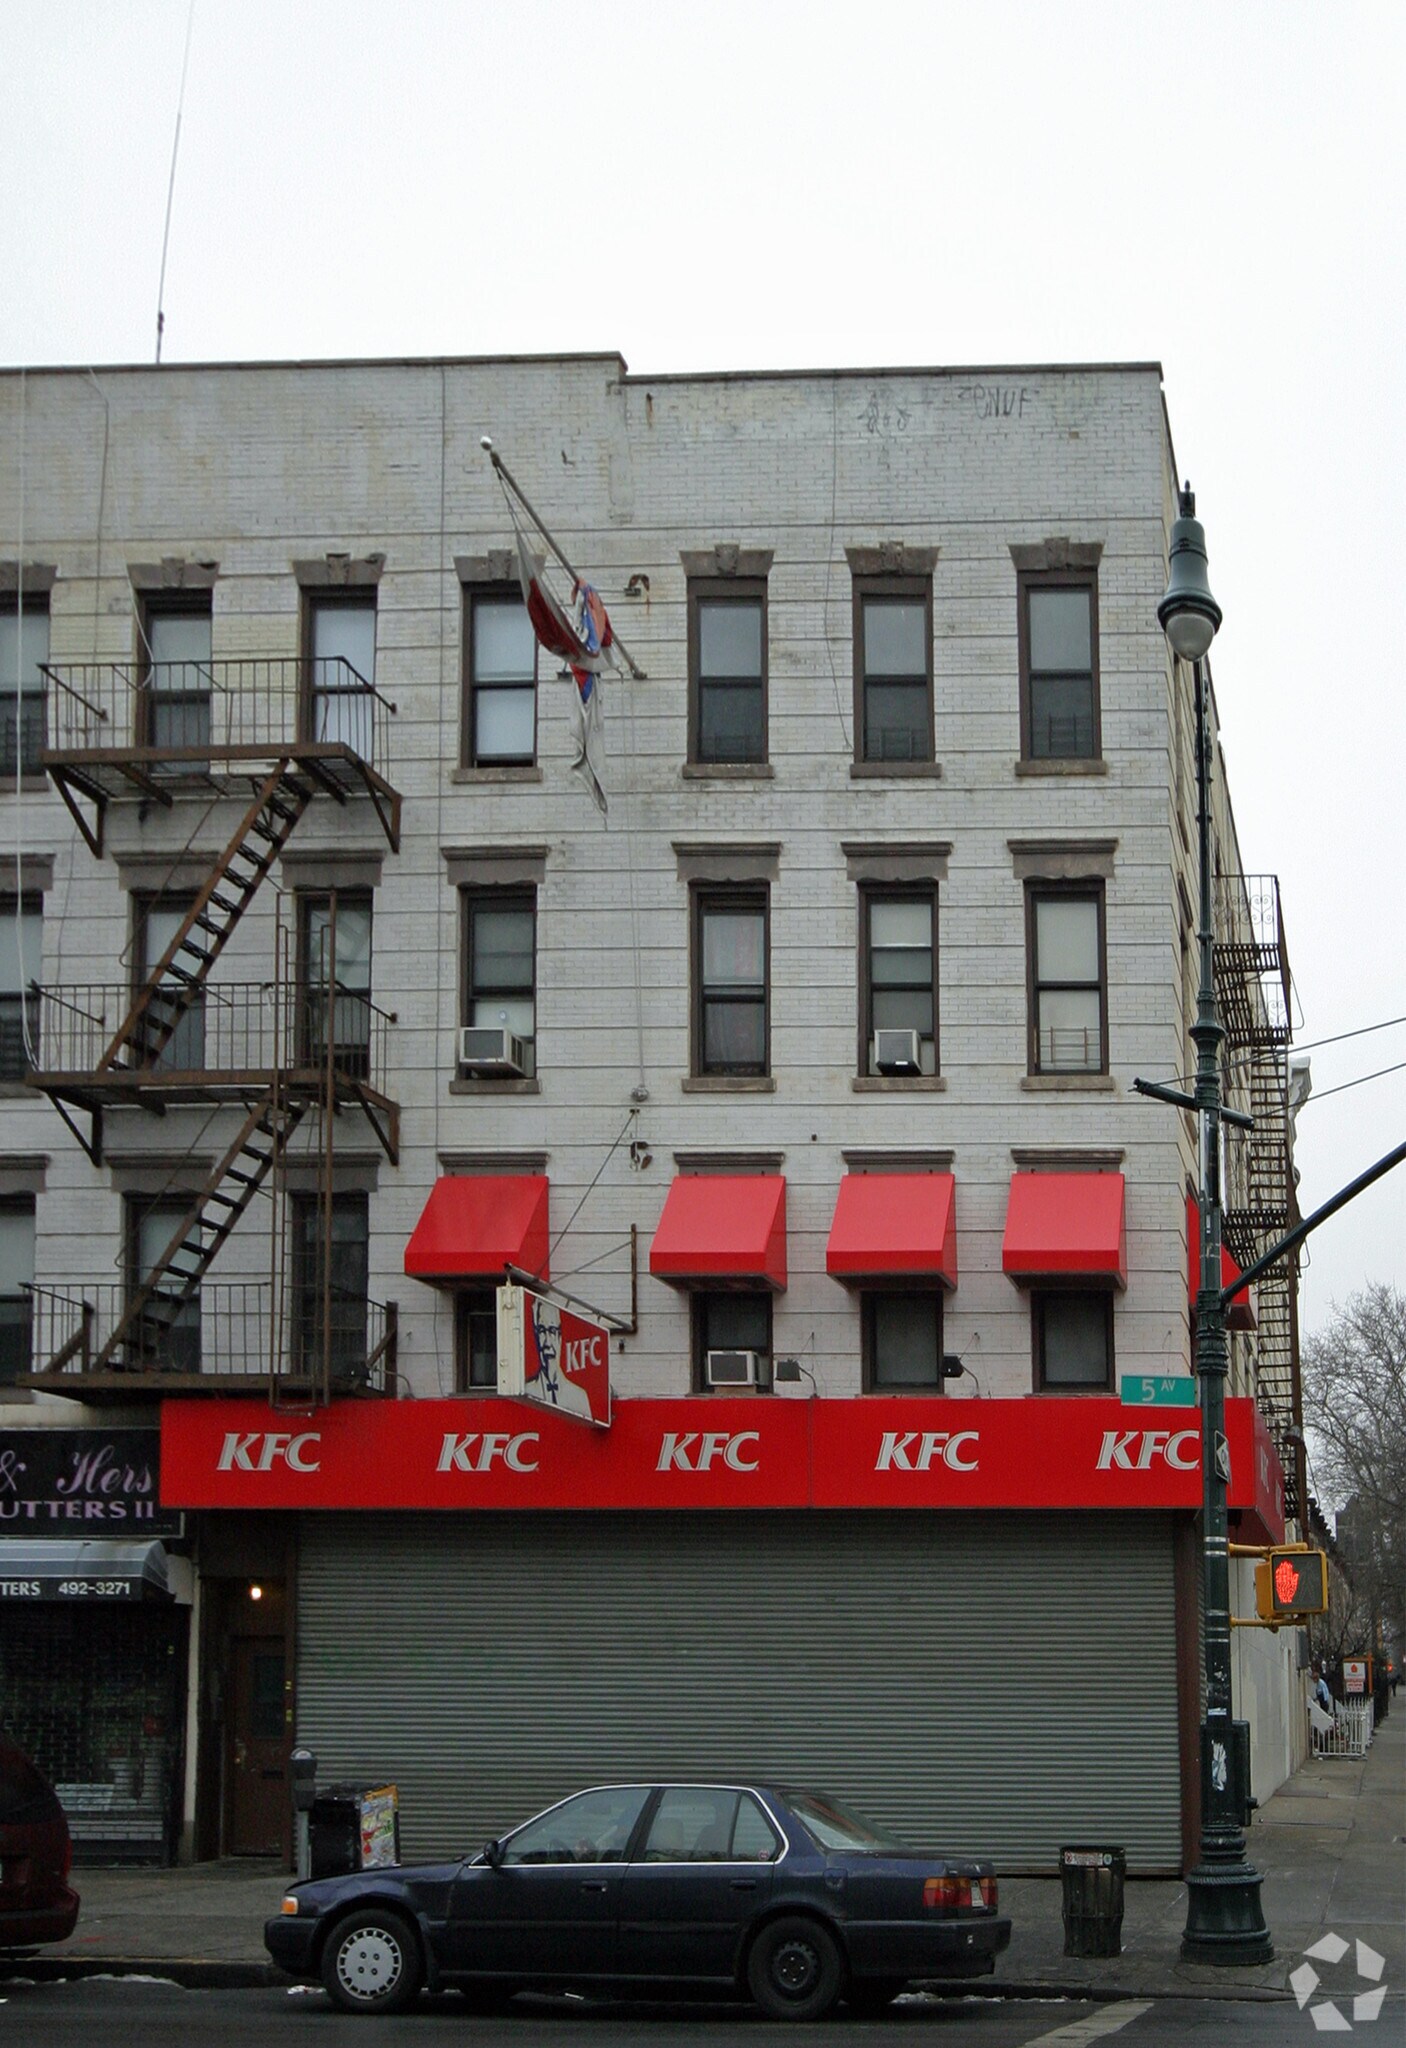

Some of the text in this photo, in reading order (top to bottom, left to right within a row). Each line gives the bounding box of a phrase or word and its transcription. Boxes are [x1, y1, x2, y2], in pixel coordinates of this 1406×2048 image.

[565, 1335, 602, 1373] KFC
[1141, 1378, 1176, 1402] 5 AV
[55, 1444, 152, 1495] Hers
[216, 1433, 321, 1472] KFC
[436, 1432, 540, 1472] KFC
[655, 1432, 760, 1472] KFC
[874, 1432, 980, 1472] KFC
[1095, 1431, 1200, 1471] KFC
[58, 1581, 130, 1596] 492-3271
